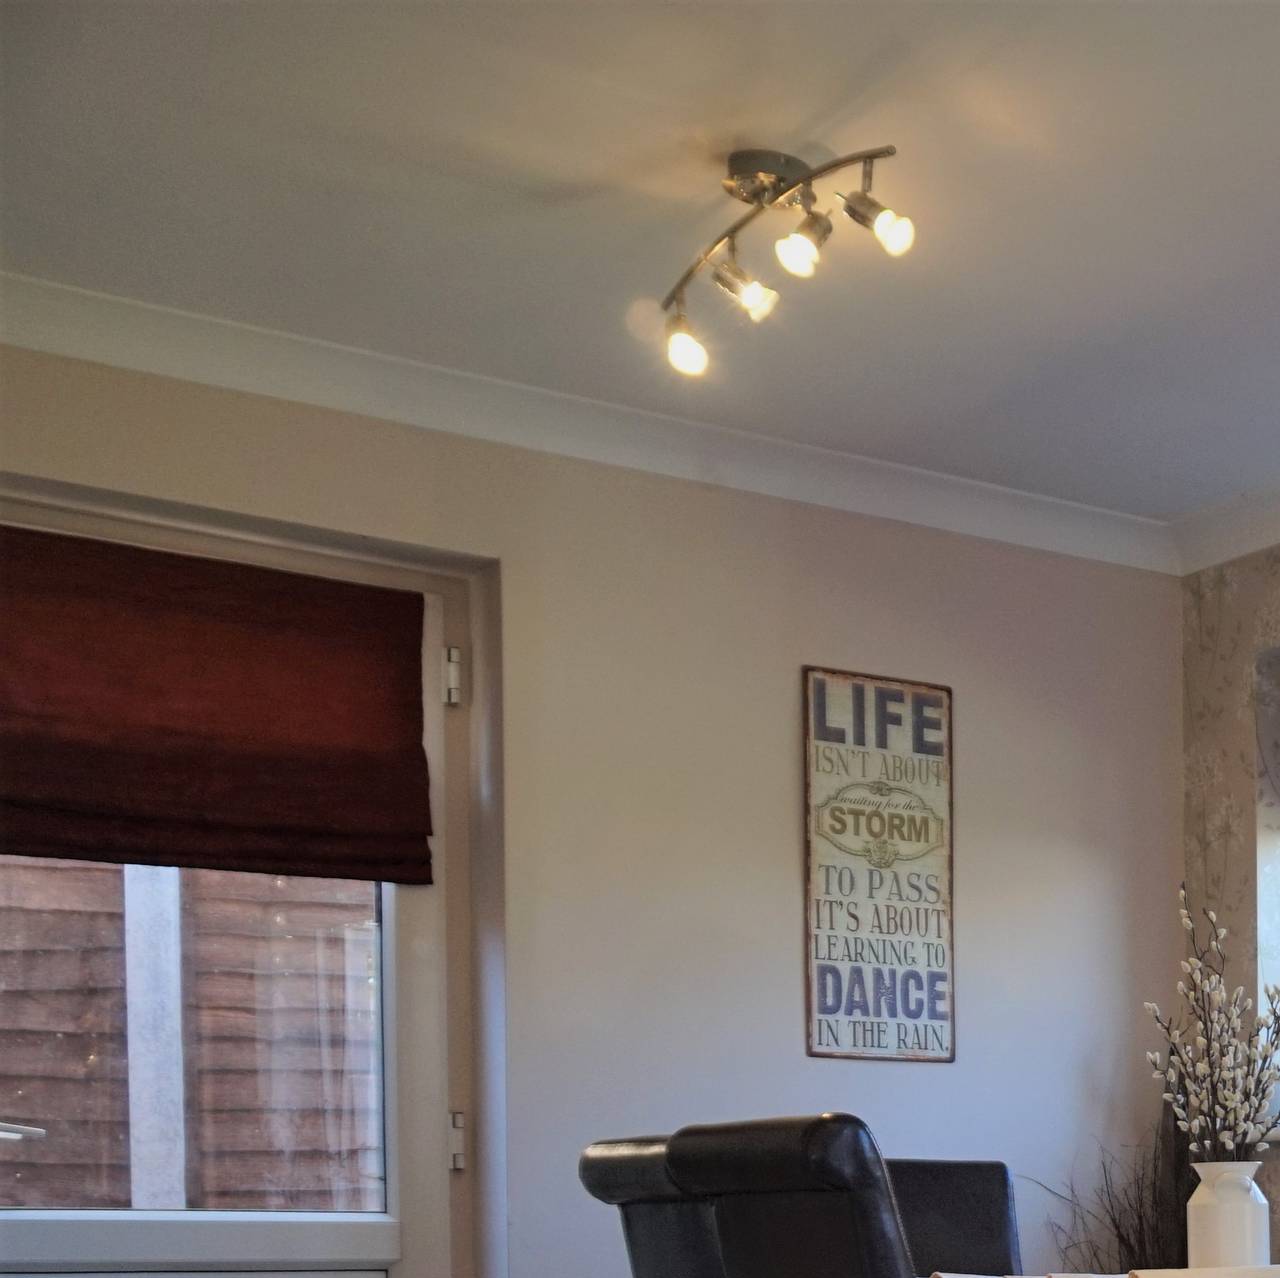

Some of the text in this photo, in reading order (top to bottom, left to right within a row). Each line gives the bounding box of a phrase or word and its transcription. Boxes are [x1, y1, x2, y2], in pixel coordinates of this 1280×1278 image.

[813, 676, 944, 757] LIFE
[815, 746, 943, 787] ISN'T ABOUT
[828, 805, 930, 843] STORM
[883, 799, 901, 809] for
[902, 800, 919, 811] the
[818, 864, 855, 897] TO
[815, 899, 946, 938] IT'S ABOUT
[814, 934, 946, 968] LEARNING TO
[816, 963, 949, 1021] DANCE
[816, 1019, 949, 1052] IN THE RAIN.
